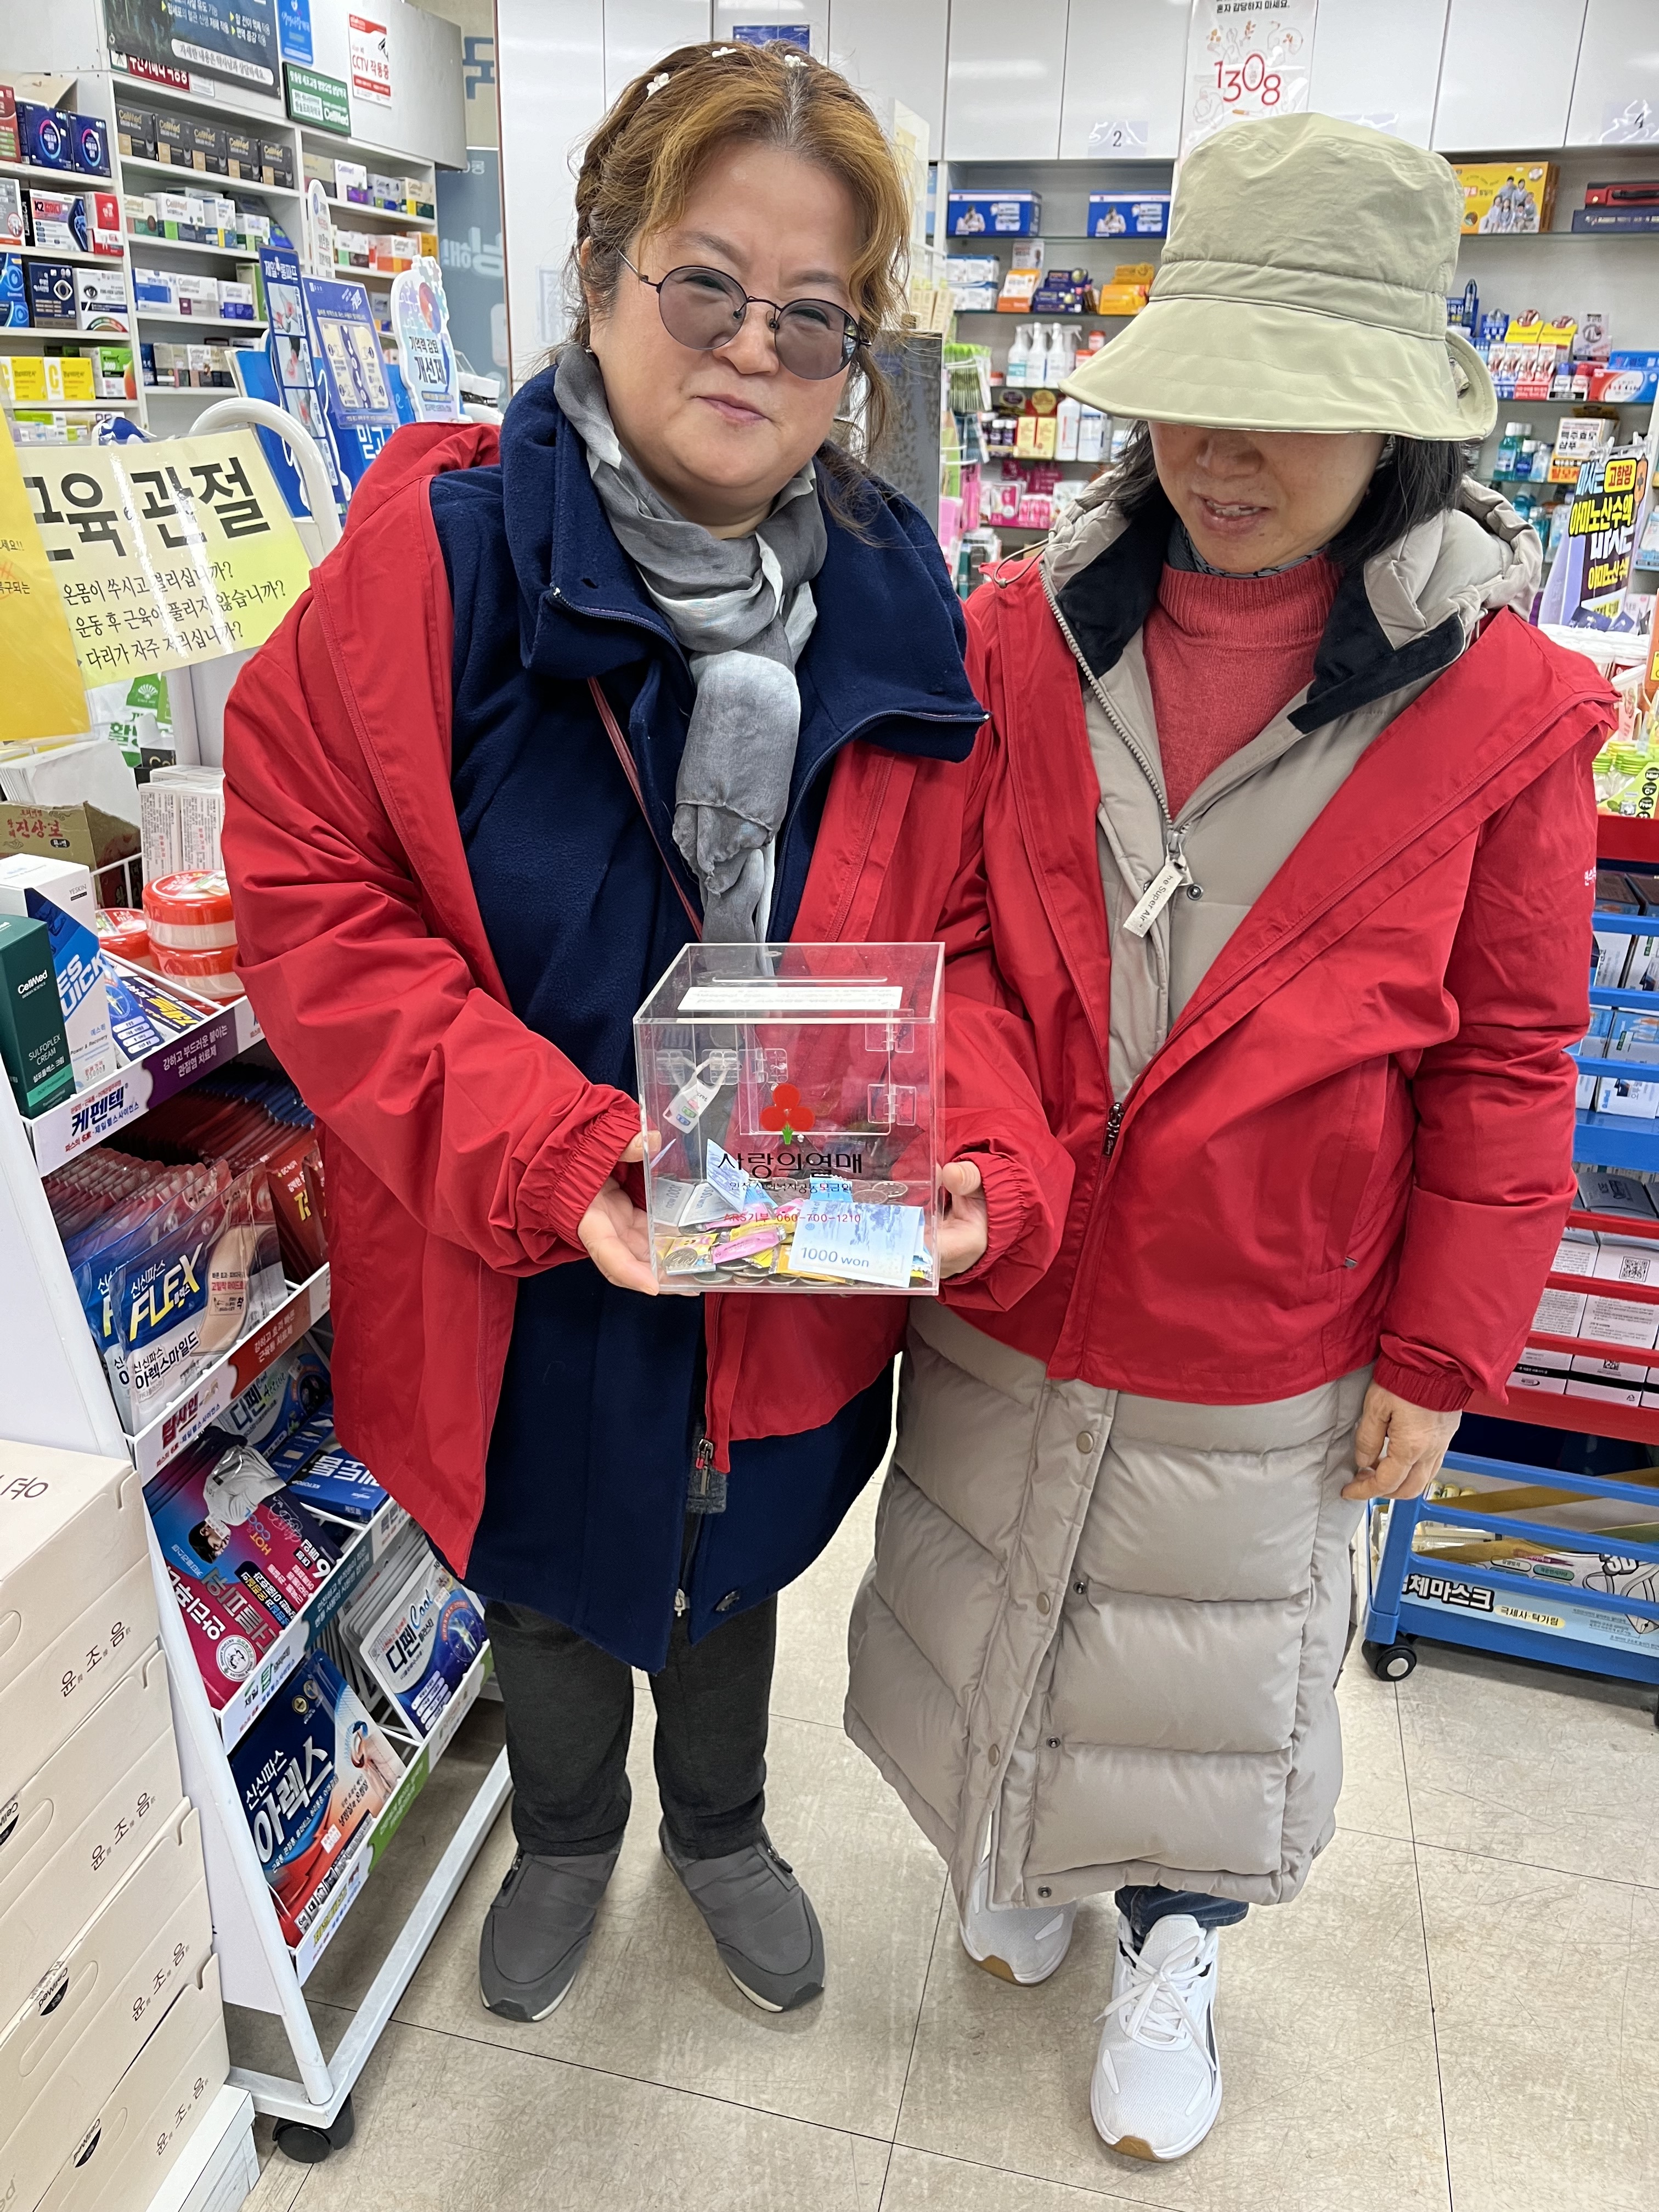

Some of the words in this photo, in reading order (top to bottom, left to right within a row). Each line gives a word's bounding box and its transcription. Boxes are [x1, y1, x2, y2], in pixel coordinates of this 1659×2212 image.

[1217, 3, 1231, 14] 혼자
[1233, 1, 1262, 12] 감당하지
[352, 54, 369, 70] CCTV
[1214, 53, 1282, 106] 1308
[1113, 131, 1122, 148] 2
[415, 357, 446, 385] 개선제
[1608, 464, 1633, 487] 고함량
[1570, 494, 1634, 536] 아미노산수액
[63, 579, 106, 606] 온몸이
[108, 575, 150, 599] 쑤시고
[76, 616, 104, 639] 운동
[106, 611, 122, 631] 후
[123, 606, 161, 630] 근육이
[167, 594, 212, 622] 풀리지
[215, 579, 287, 613] 않습니까?
[86, 642, 130, 671] 다리가
[133, 638, 160, 660] 자주
[69, 884, 87, 895] YESKIN
[1147, 886, 1166, 910] Super
[18, 970, 48, 994] CellMed
[29, 1033, 61, 1061] SULFOPLEX
[37, 1047, 57, 1066] CREAM
[70, 1045, 86, 1056] Power
[93, 1034, 108, 1047] Recovery
[162, 1051, 183, 1072] 강하고
[184, 1036, 209, 1062] 부드러운
[209, 1024, 229, 1047] 붙이는
[178, 1058, 198, 1079] 관절염
[198, 1045, 217, 1068] 치료제
[71, 1088, 125, 1137] 케펜텍
[718, 1152, 862, 1179] 사랑의열매
[723, 1213, 769, 1223] ARS기부
[776, 1213, 861, 1223] 060-700-1210
[800, 1246, 839, 1263] 1000
[840, 1254, 870, 1268] won
[129, 1262, 166, 1299] 신신파스
[129, 1242, 204, 1342] FLEX
[133, 1346, 165, 1374] 신신파스
[134, 1329, 200, 1390] 아렉스마일드
[230, 1384, 263, 1426] 디펜
[250, 1534, 272, 1556] HOT
[252, 1571, 281, 1602] 이중효과
[1402, 1573, 1494, 1611] 체마스크
[201, 1567, 280, 1655] 더블파워
[409, 1590, 435, 1632] Cool
[385, 1630, 419, 1673] 디펜
[245, 1750, 285, 1810] 신신파스
[253, 1735, 334, 1865] 아렉스
[38, 1966, 69, 2008] CellMed
[72, 2118, 101, 2161] CellMed
